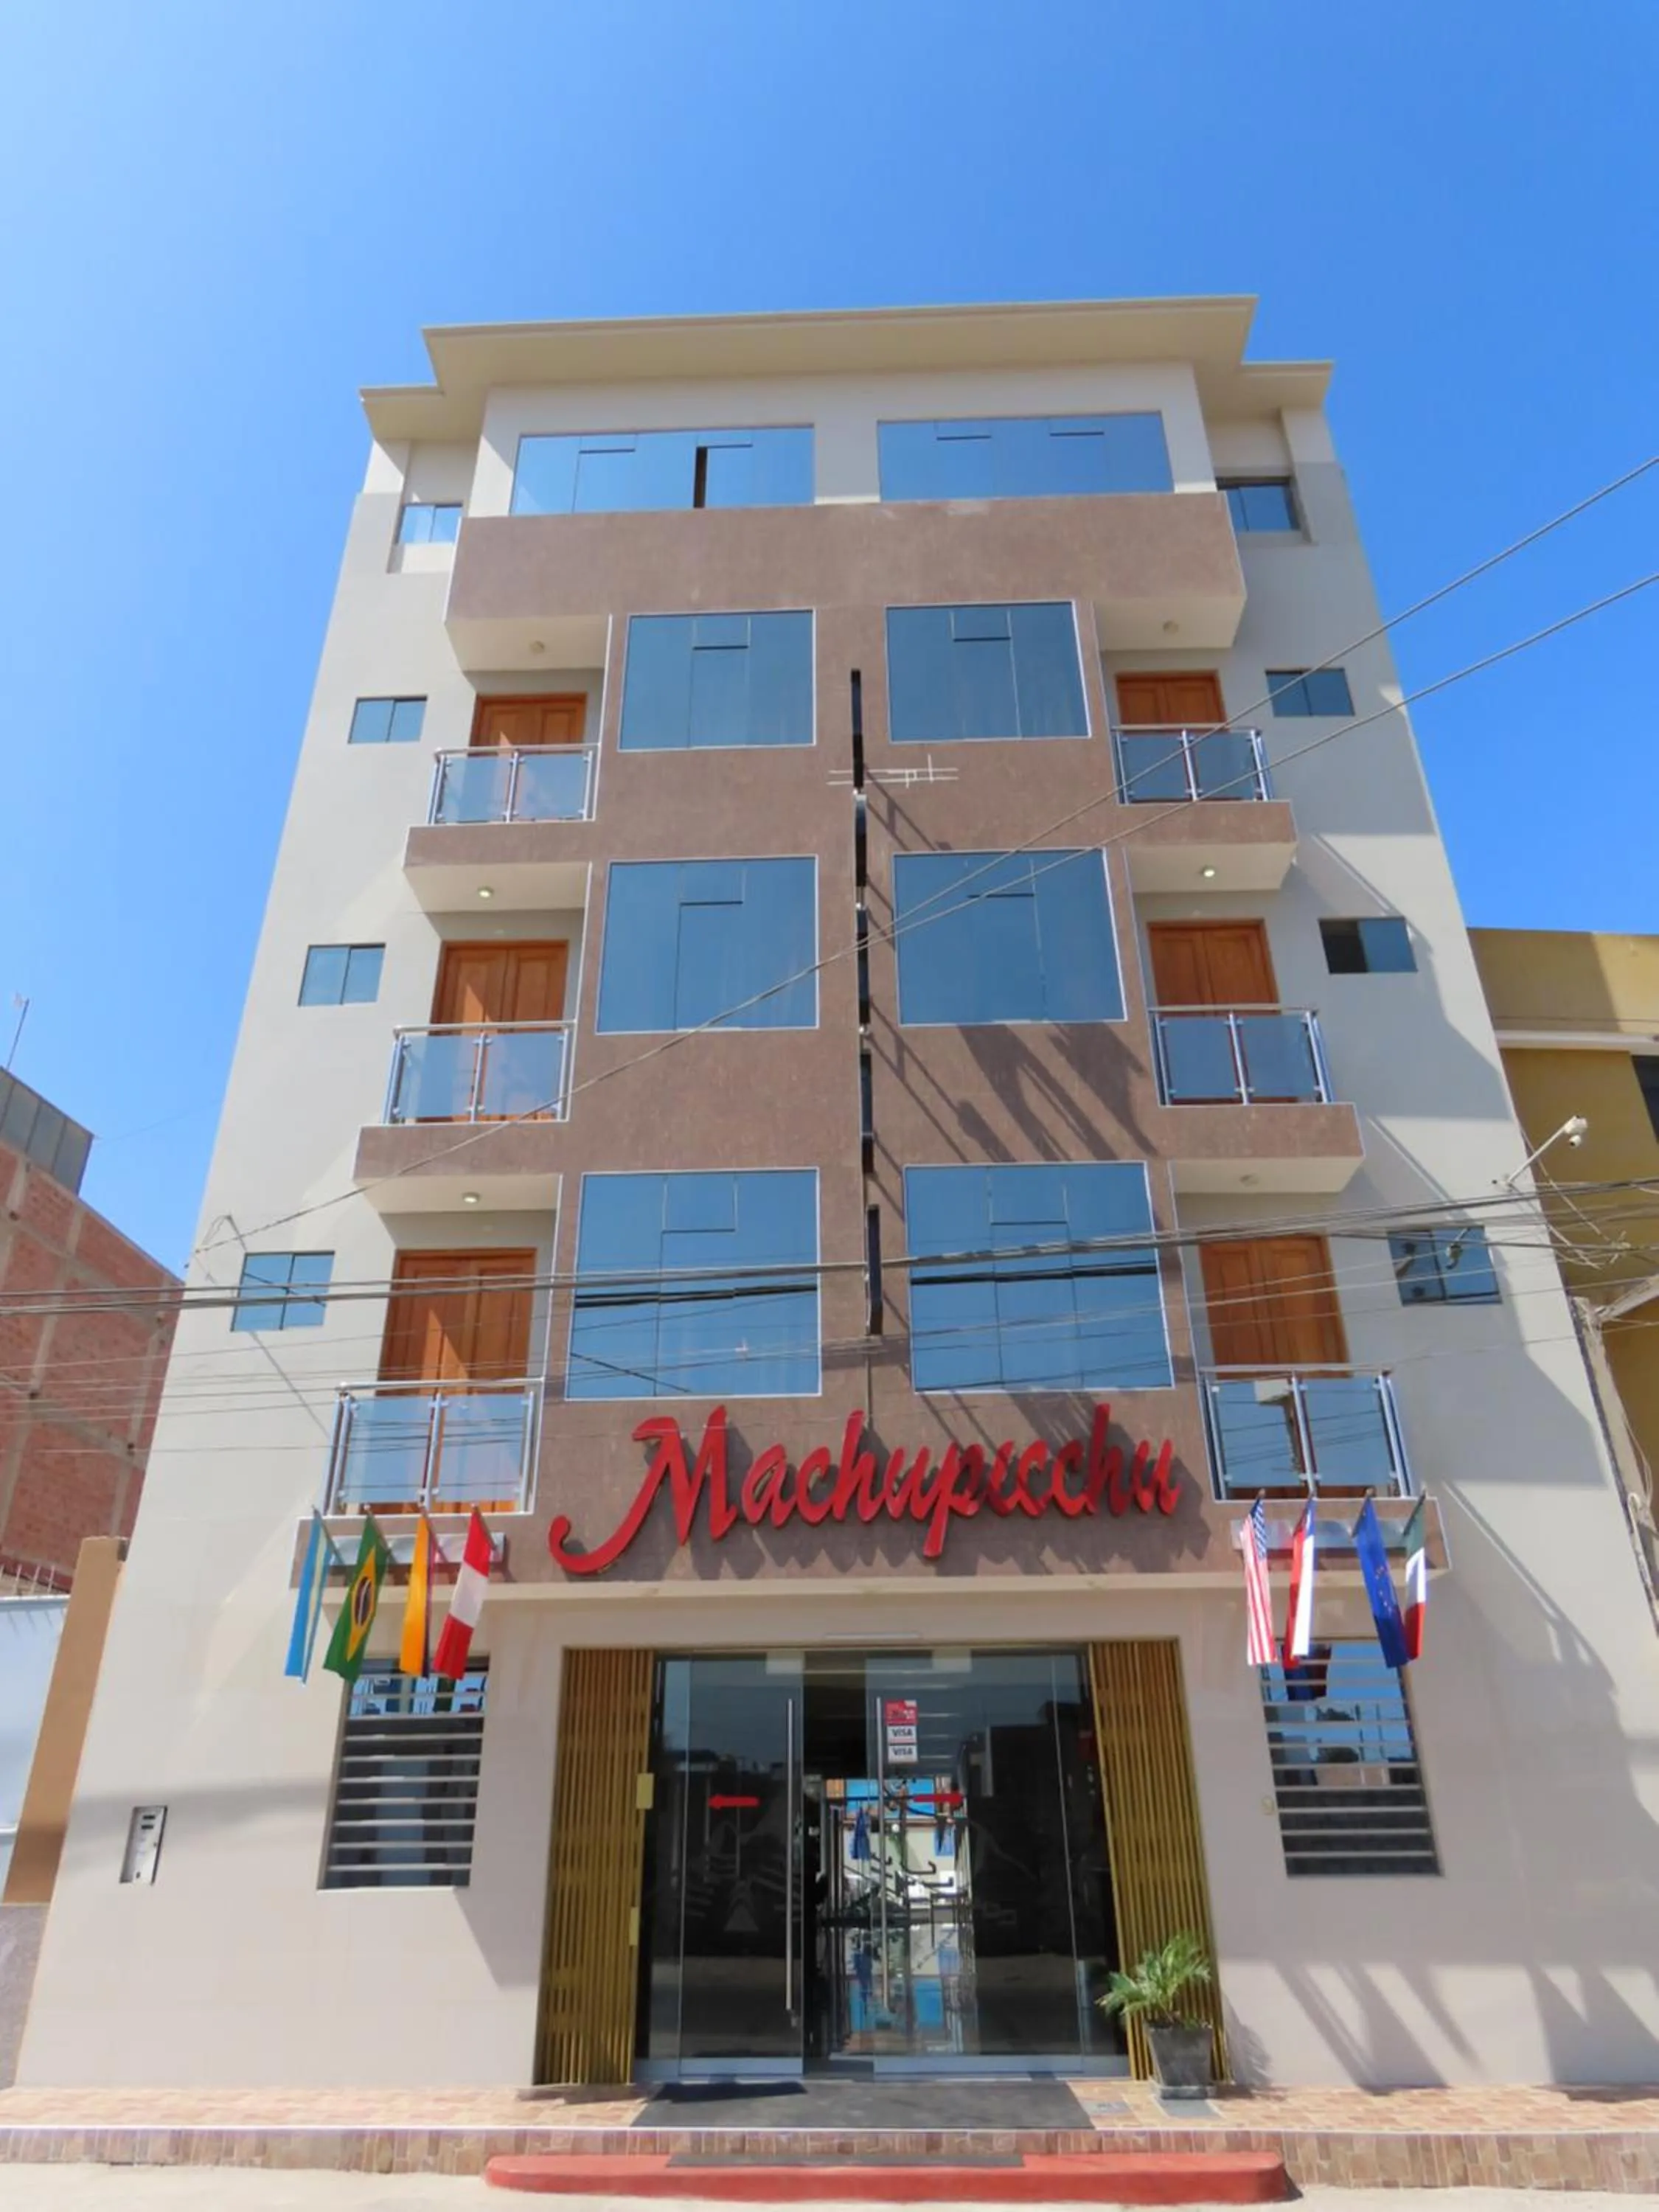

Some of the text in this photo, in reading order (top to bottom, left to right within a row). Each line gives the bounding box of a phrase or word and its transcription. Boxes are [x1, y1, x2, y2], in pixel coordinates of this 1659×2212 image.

[549, 1404, 1180, 1573] Machupicchu
[891, 1728, 913, 1736] VISA
[892, 1747, 913, 1756] VISA
